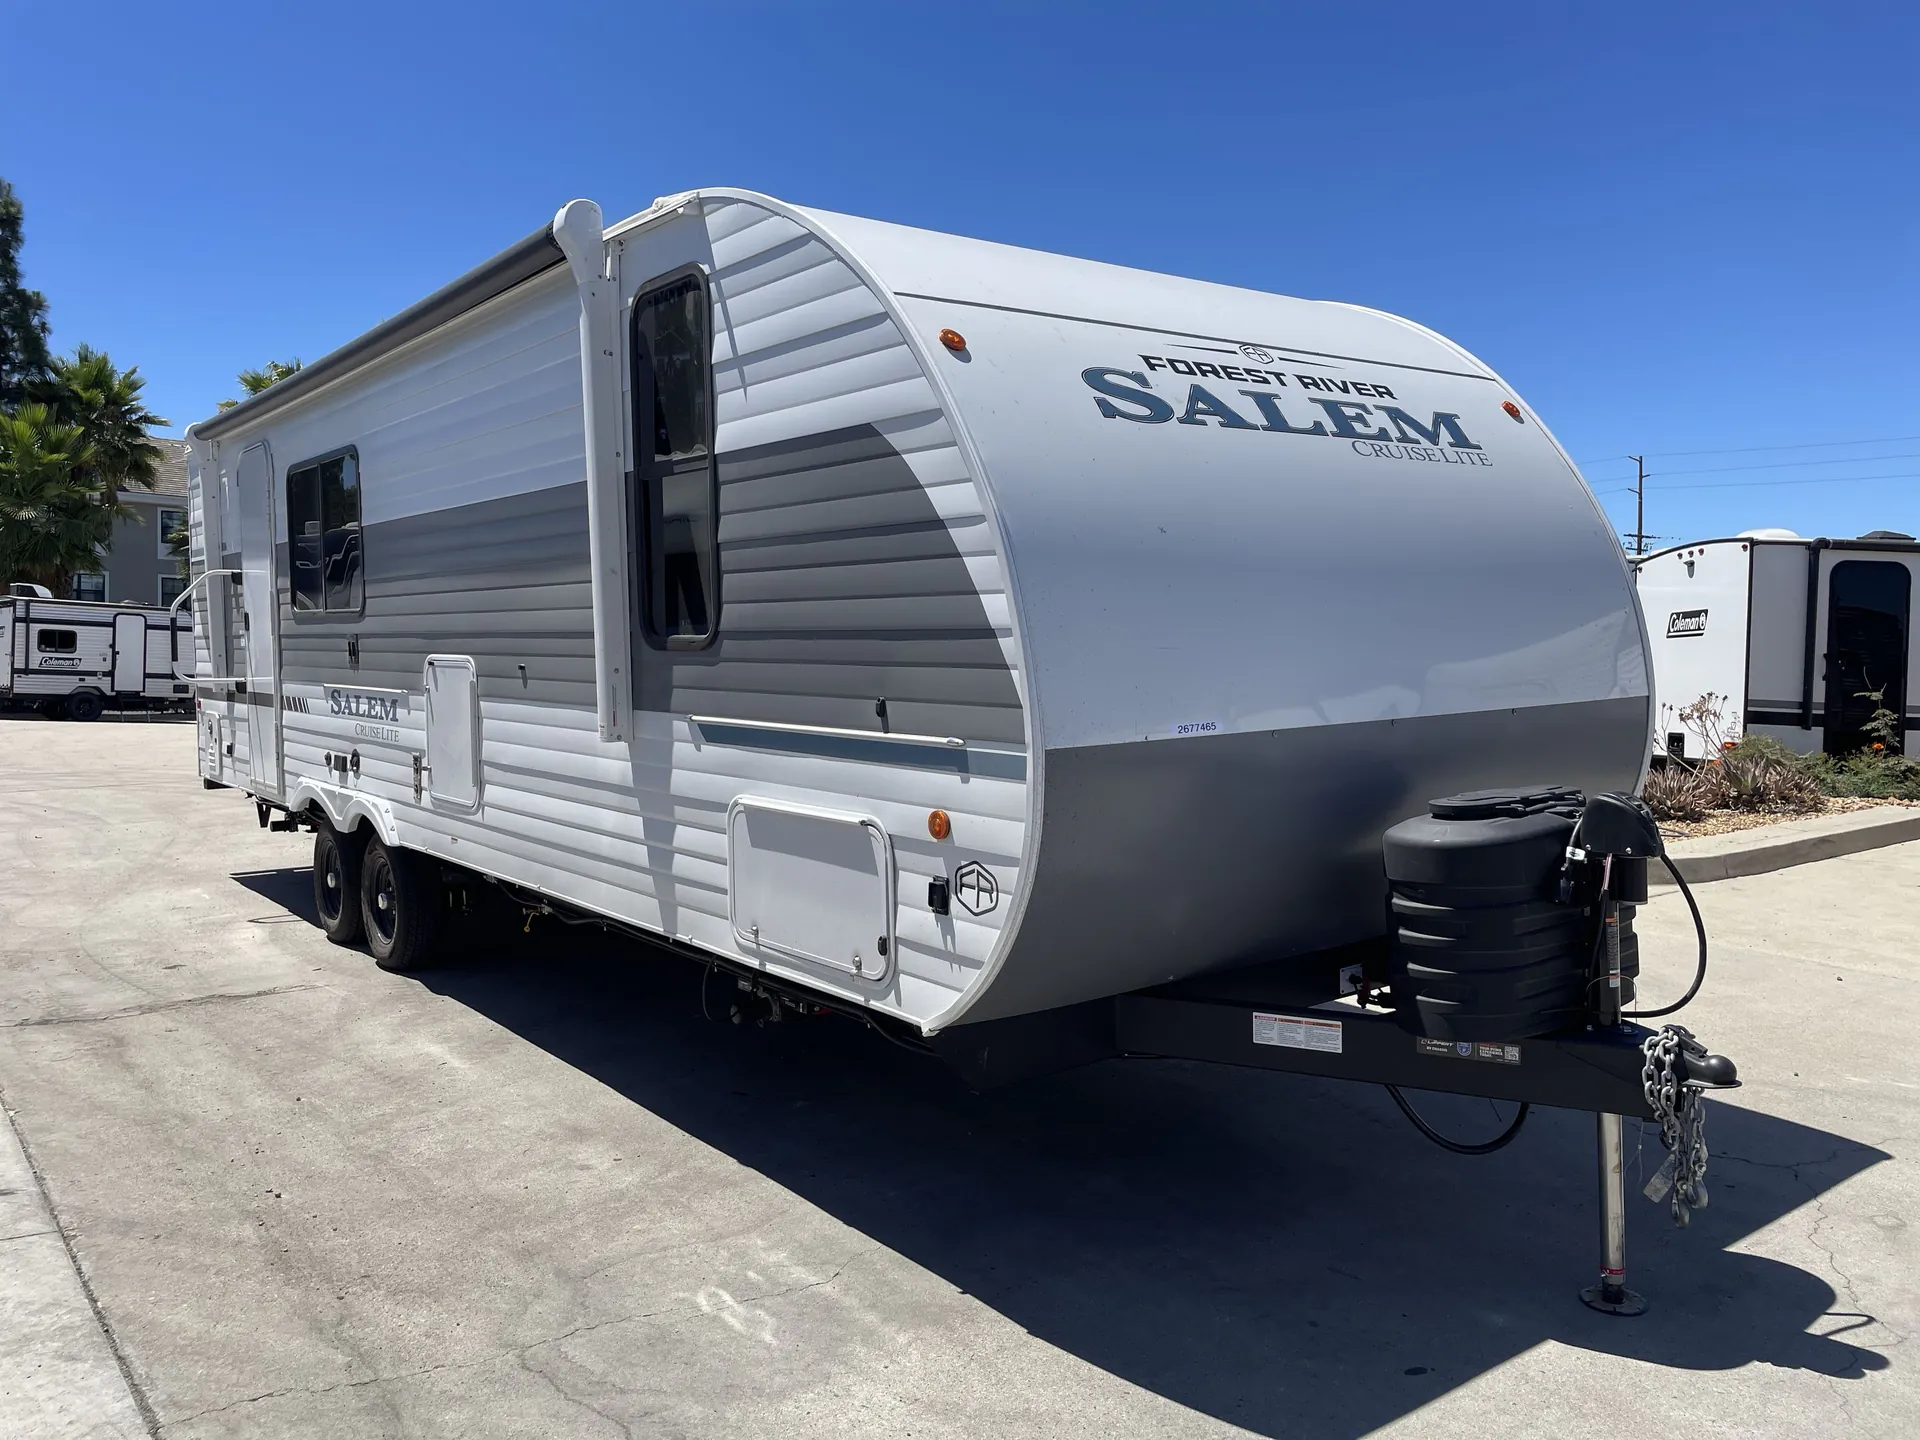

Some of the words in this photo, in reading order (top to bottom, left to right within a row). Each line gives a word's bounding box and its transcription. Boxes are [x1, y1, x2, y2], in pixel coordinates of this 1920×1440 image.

[1137, 354, 1287, 387] FOREST
[1292, 373, 1398, 400] RIVER
[1081, 366, 1483, 451] SALEM
[1669, 613, 1700, 633] Coleman
[41, 657, 73, 667] Coleman
[330, 688, 399, 723] SALEM
[1177, 721, 1217, 734] 2677465
